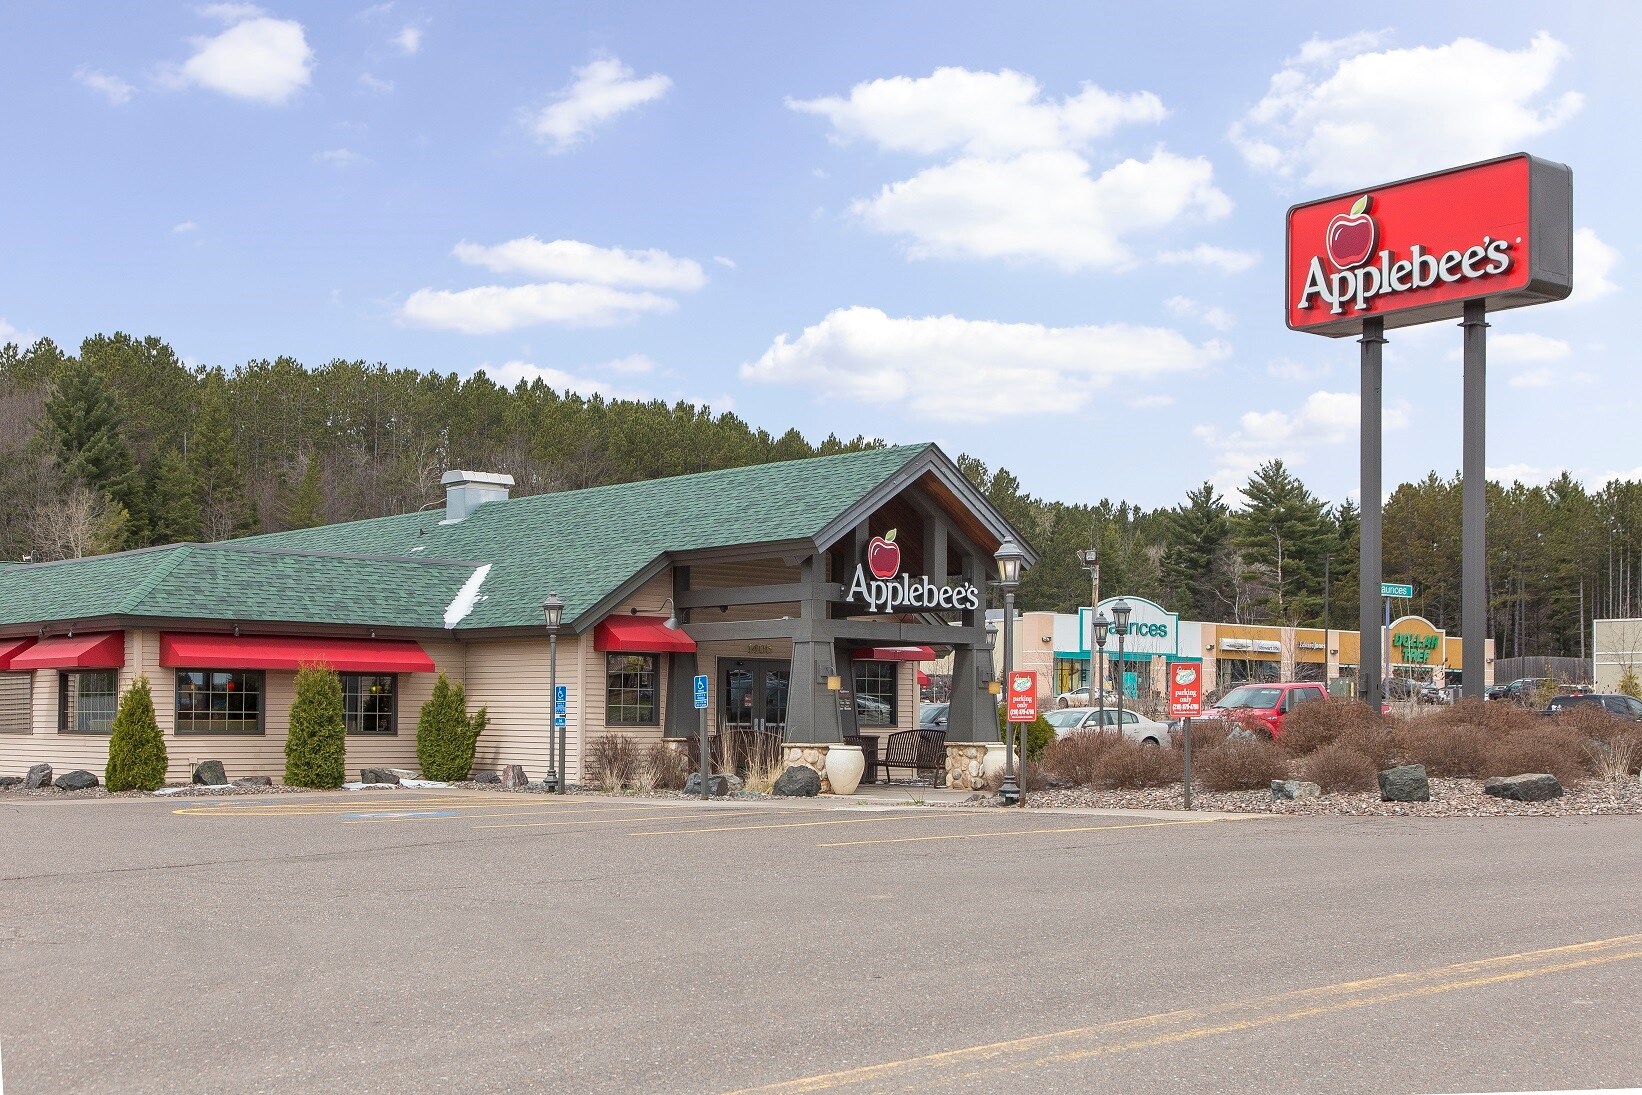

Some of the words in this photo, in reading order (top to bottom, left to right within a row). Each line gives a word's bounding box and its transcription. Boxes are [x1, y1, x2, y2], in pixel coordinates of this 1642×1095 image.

[1298, 236, 1511, 314] Applebee's
[846, 563, 979, 613] Applebee's
[1381, 586, 1407, 595] aurices
[1394, 633, 1439, 649] DOLLAR
[1402, 649, 1430, 662] TREE
[1175, 688, 1197, 697] parking
[1012, 695, 1033, 704] parking
[1179, 695, 1192, 704] only
[1016, 701, 1028, 709] only
